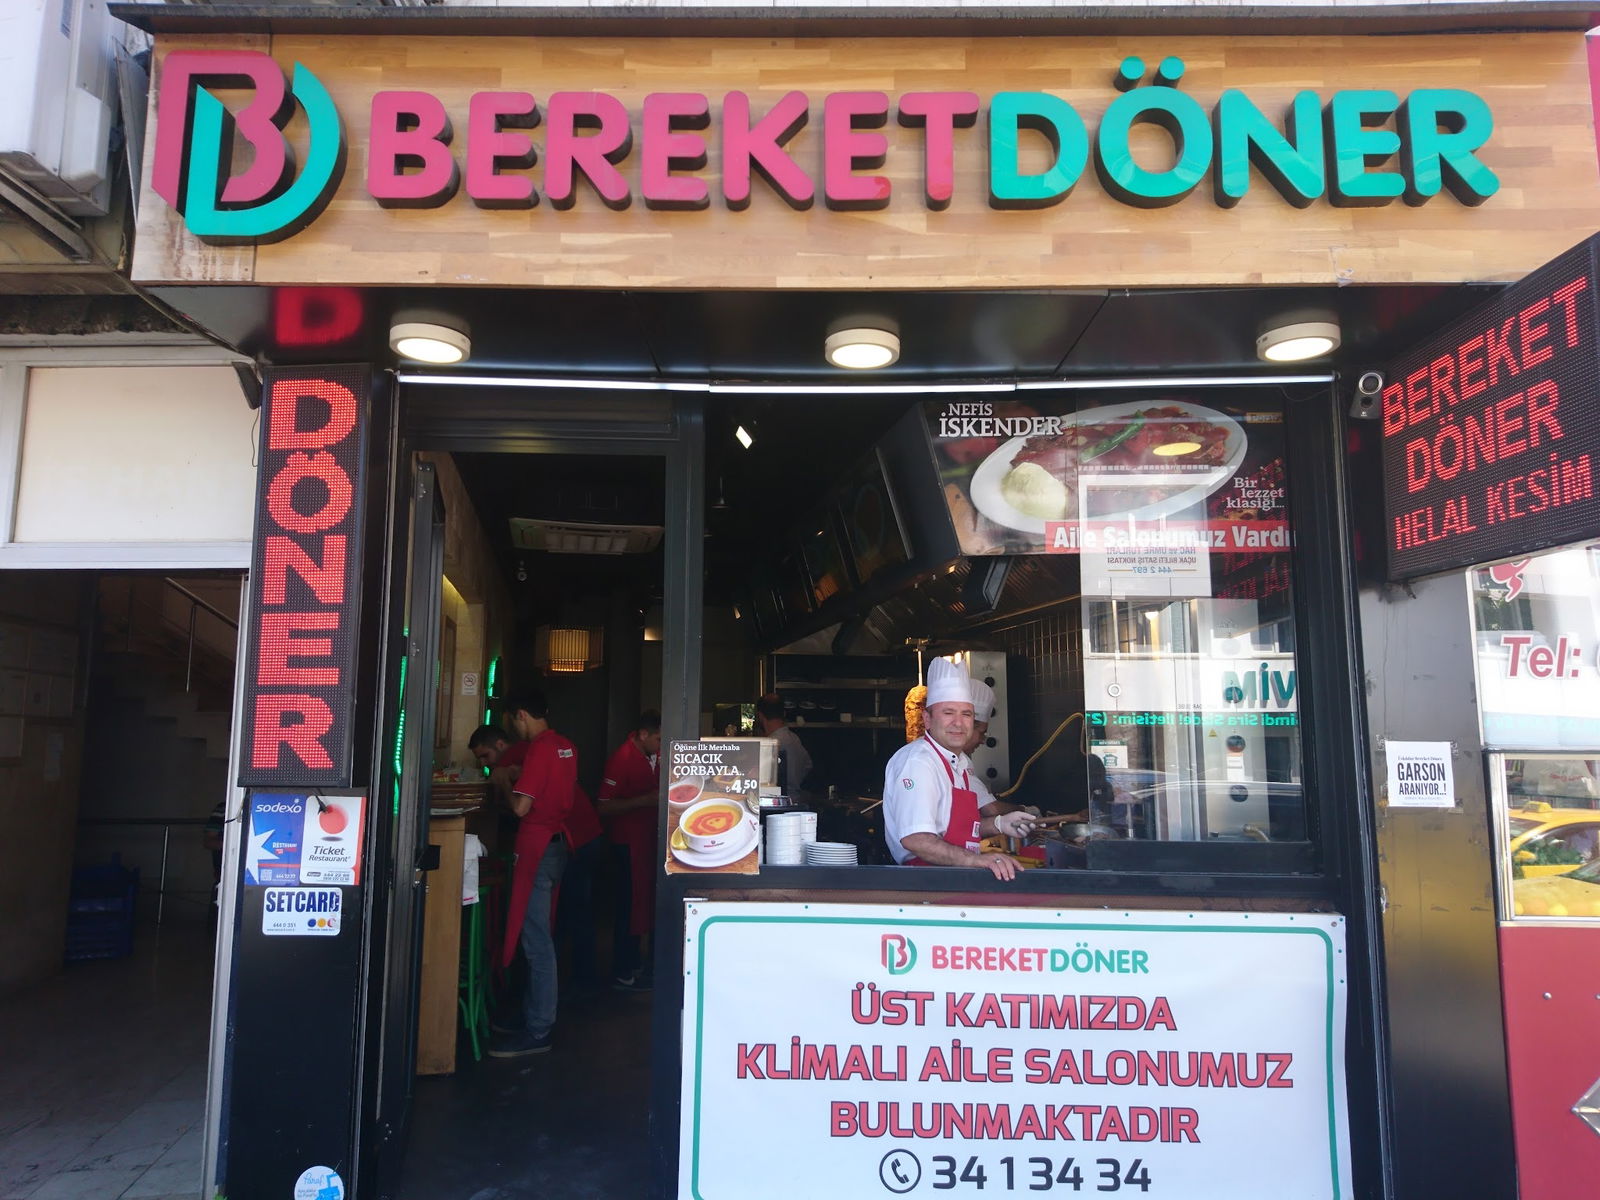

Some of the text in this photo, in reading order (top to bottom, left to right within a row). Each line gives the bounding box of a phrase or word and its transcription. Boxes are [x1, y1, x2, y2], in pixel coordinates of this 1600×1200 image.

[1382, 275, 1588, 438] BEREKET
[948, 400, 993, 416] NEFİS
[939, 411, 1064, 437] İSKENDER
[1405, 379, 1566, 494] DÖNER
[1233, 477, 1258, 488] Bir
[1241, 488, 1284, 498] lezzet
[1394, 452, 1594, 550] HELAL KESİM
[1053, 525, 1098, 548] Aile
[252, 378, 357, 769] DÖNER
[1502, 635, 1582, 679] Tel:
[673, 753, 723, 764] SICACIK
[674, 743, 697, 752] Öğüne
[709, 743, 741, 751] Merhaba
[1397, 762, 1446, 781] GARSON
[255, 801, 302, 814] sodexo
[313, 845, 346, 856] Ticket
[850, 981, 1178, 1032] ÜST KATIMIZDA
[736, 1036, 1294, 1089] KLİMALI AİLE SALONUMUZ
[829, 1100, 1200, 1143] BULUNMAKTADIR
